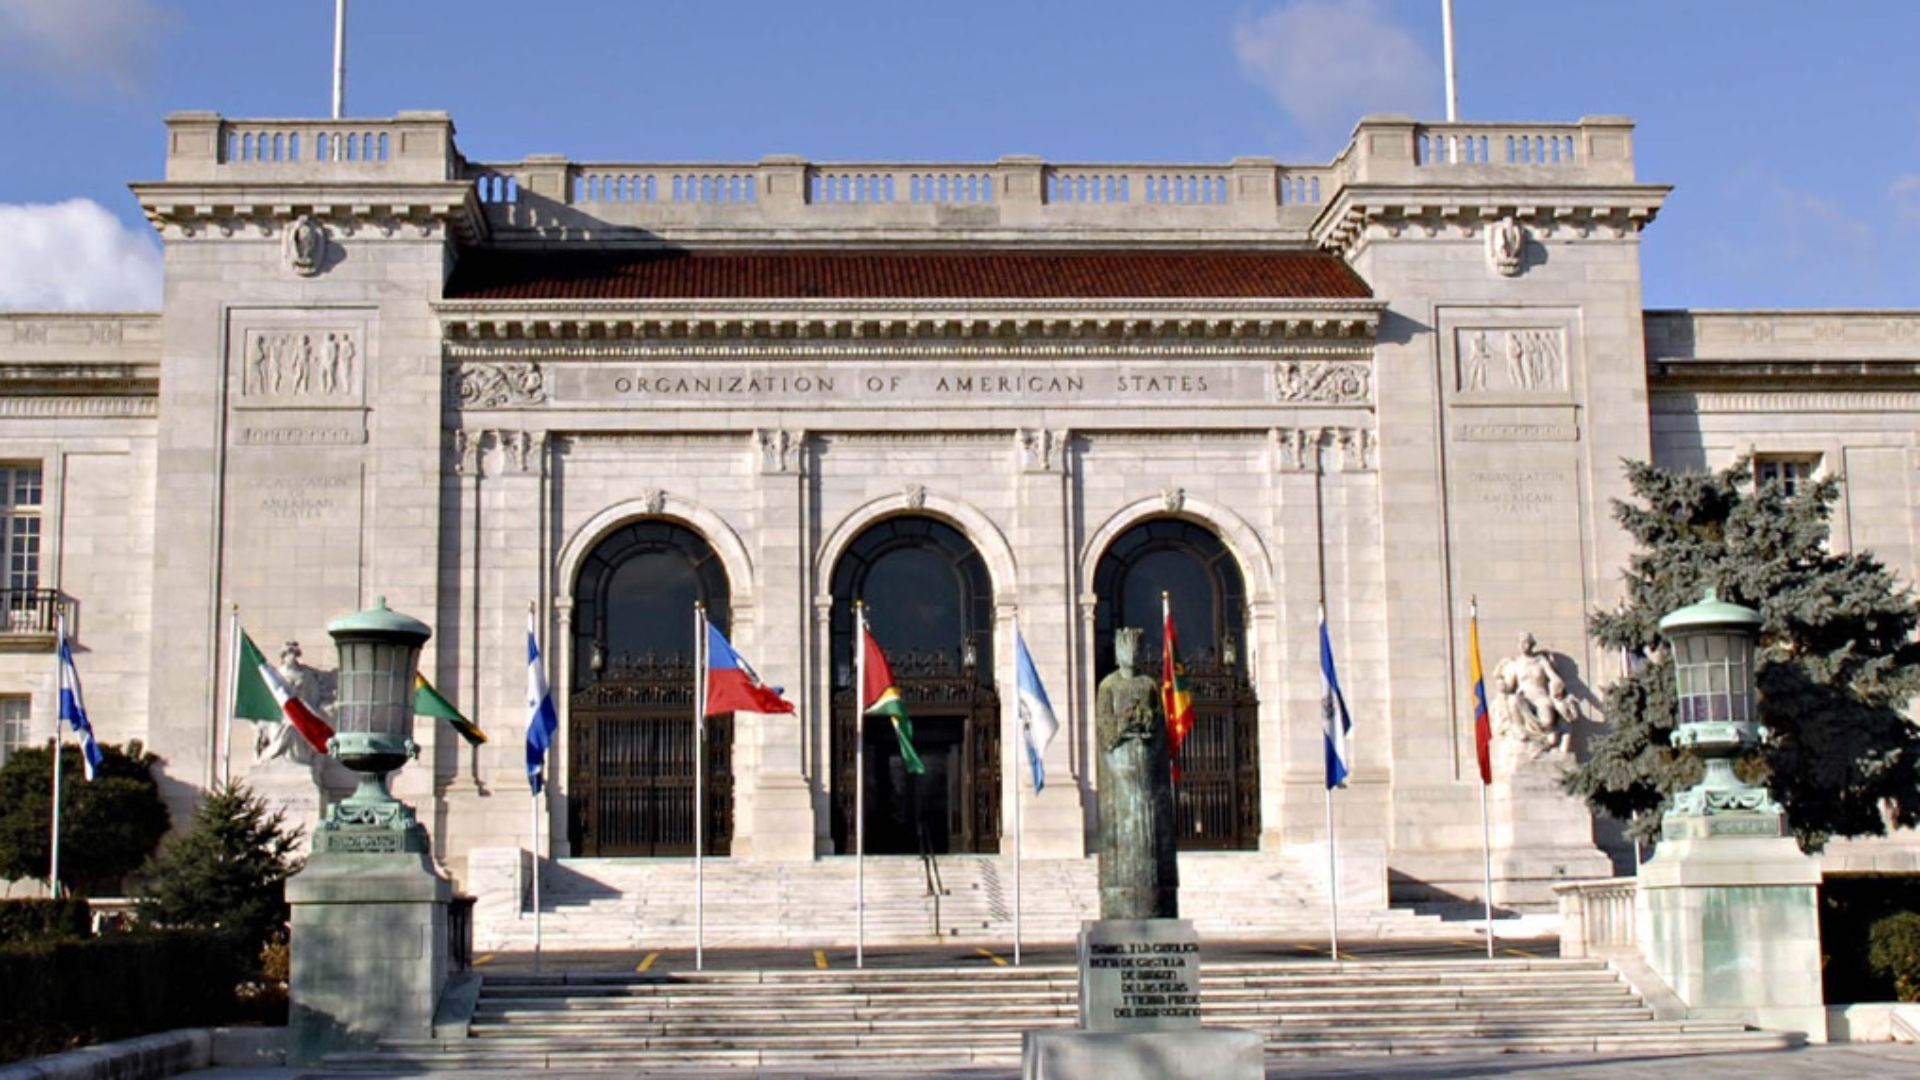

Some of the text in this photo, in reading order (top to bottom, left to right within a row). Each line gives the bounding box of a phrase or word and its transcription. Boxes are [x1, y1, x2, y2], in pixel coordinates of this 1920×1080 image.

[614, 375, 1209, 393] ORGANIZATION OF AMERICAN STATES
[1121, 957, 1134, 968] DE
[1121, 970, 1134, 980] DE
[1121, 983, 1134, 993] DE
